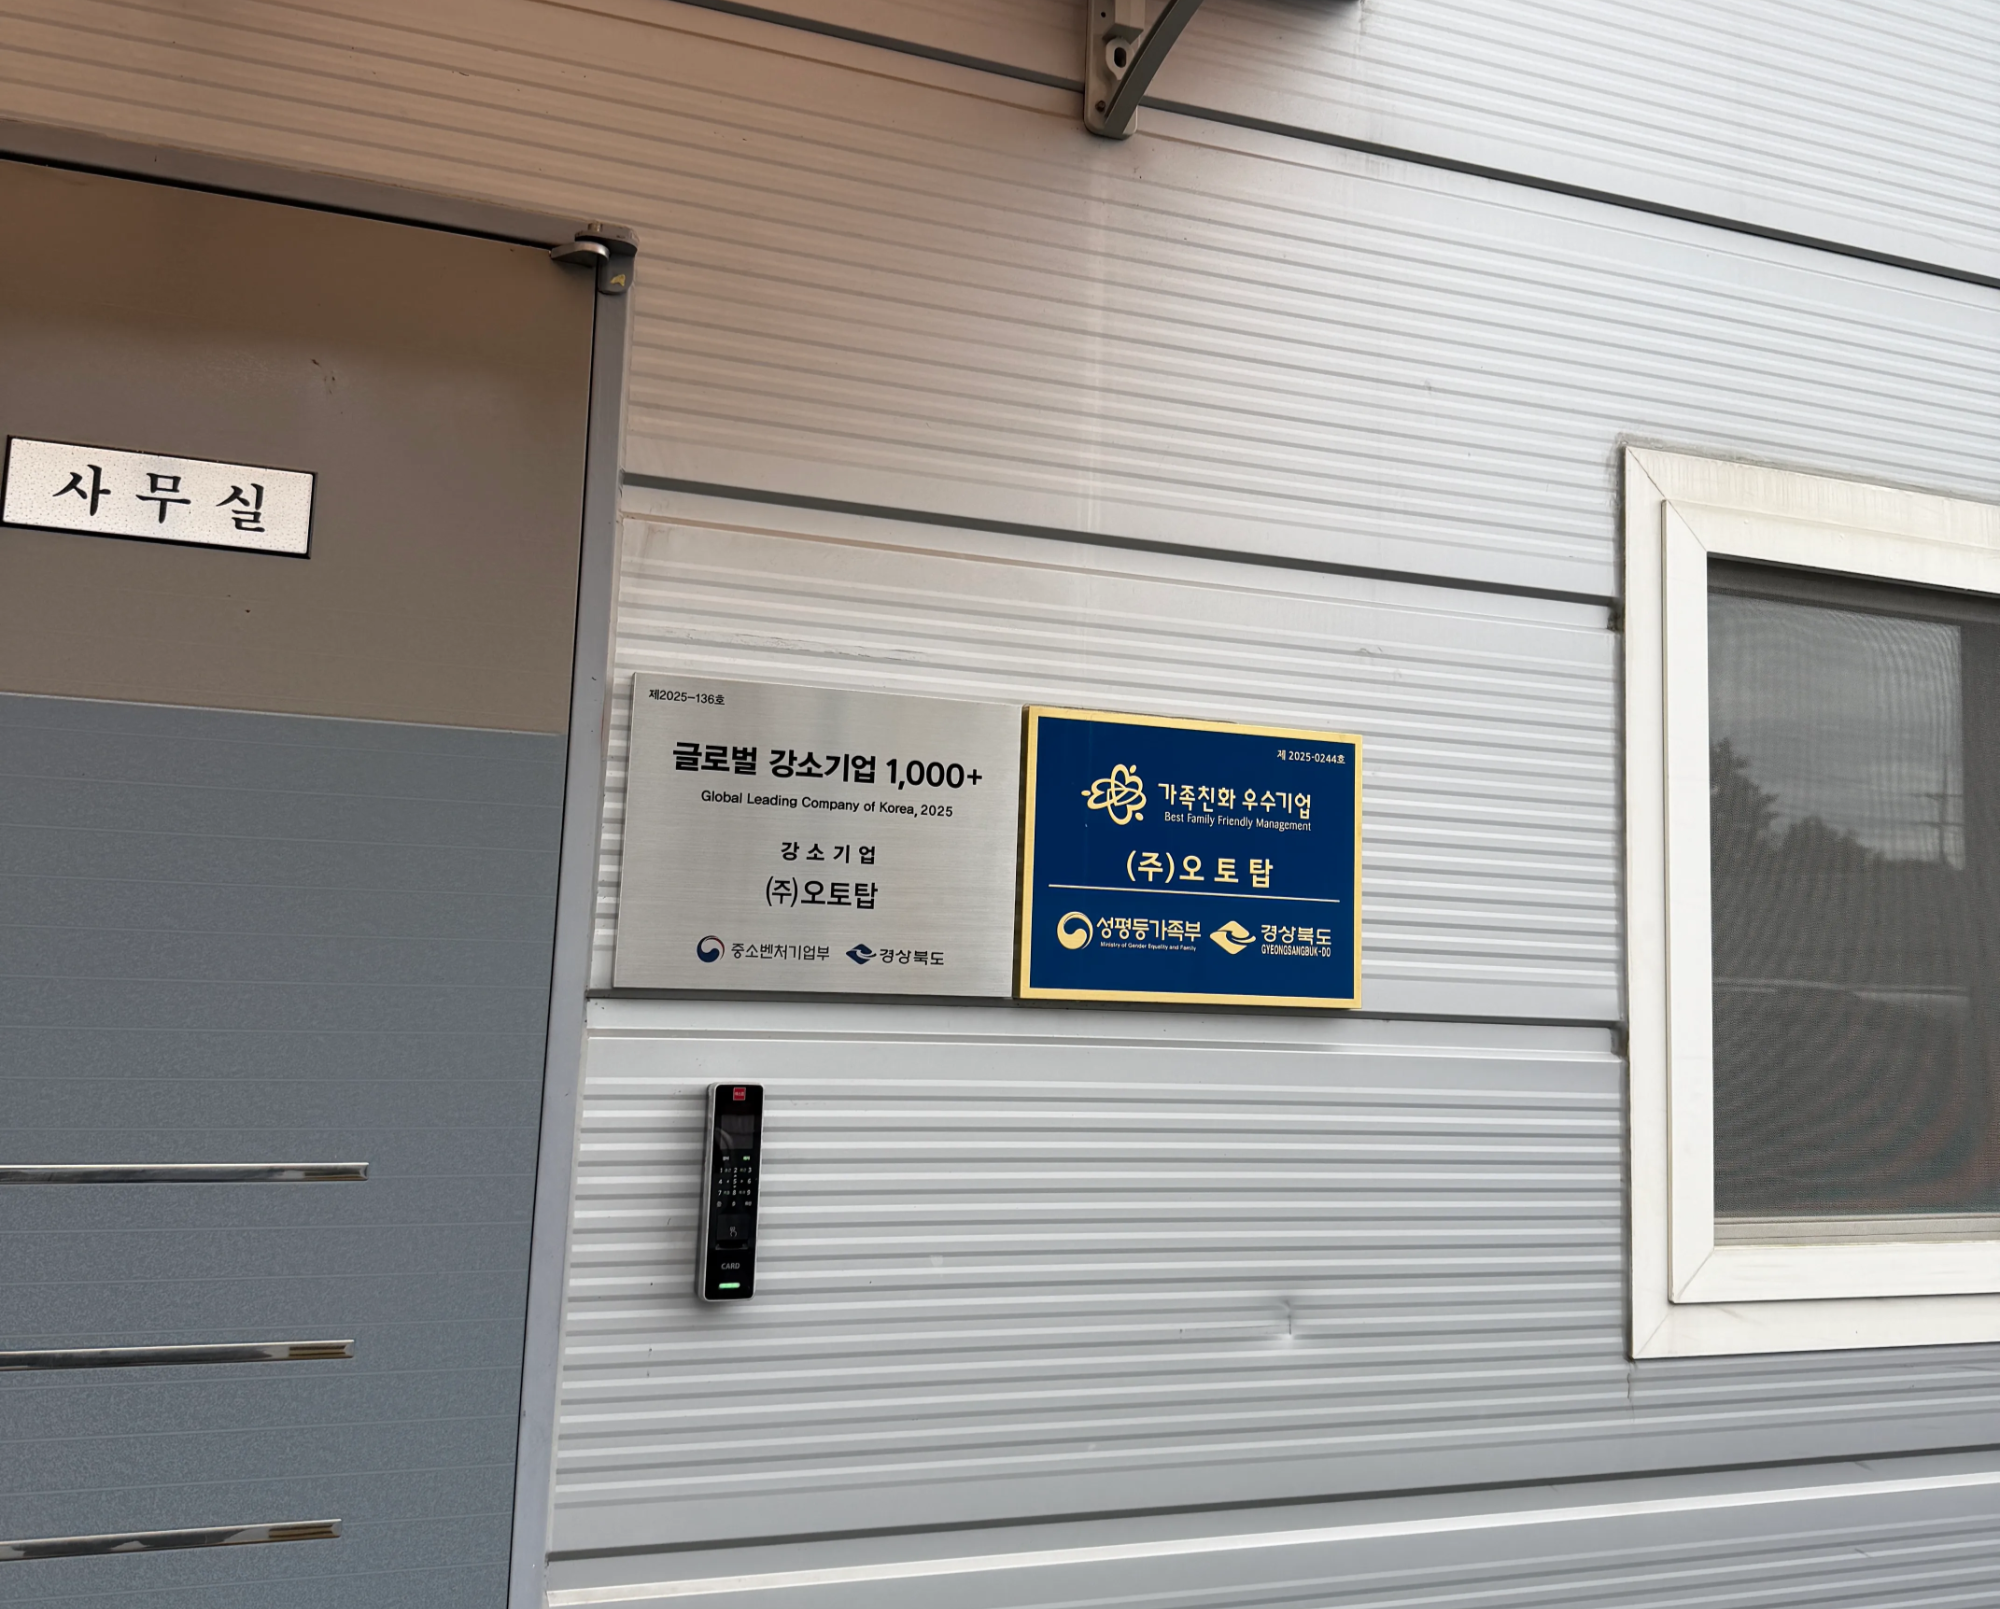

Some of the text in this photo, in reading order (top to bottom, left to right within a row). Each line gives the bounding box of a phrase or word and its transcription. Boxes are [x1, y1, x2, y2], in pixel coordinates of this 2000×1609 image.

[53, 464, 265, 533] 사무실
[673, 742, 982, 790] 글로벌 강소기업 1,000+
[1277, 750, 1345, 763] 제 2025-0244호
[702, 790, 952, 817] Global Leading Company of Korea, 2025
[1158, 784, 1310, 819] 가족친화 우수기업
[1165, 812, 1310, 831] Best Family Friendly Management
[766, 876, 878, 909] (주)오토탑
[1097, 917, 1201, 941] 성평등가족부
[1262, 925, 1331, 944] 경상북도
[732, 944, 829, 960] 중소벤처기업부
[880, 949, 943, 965] 경상북도
[1148, 943, 1168, 951] Equality
[1180, 944, 1196, 952] Family
[1262, 944, 1331, 957] GYEONGSANGBUK-DO
